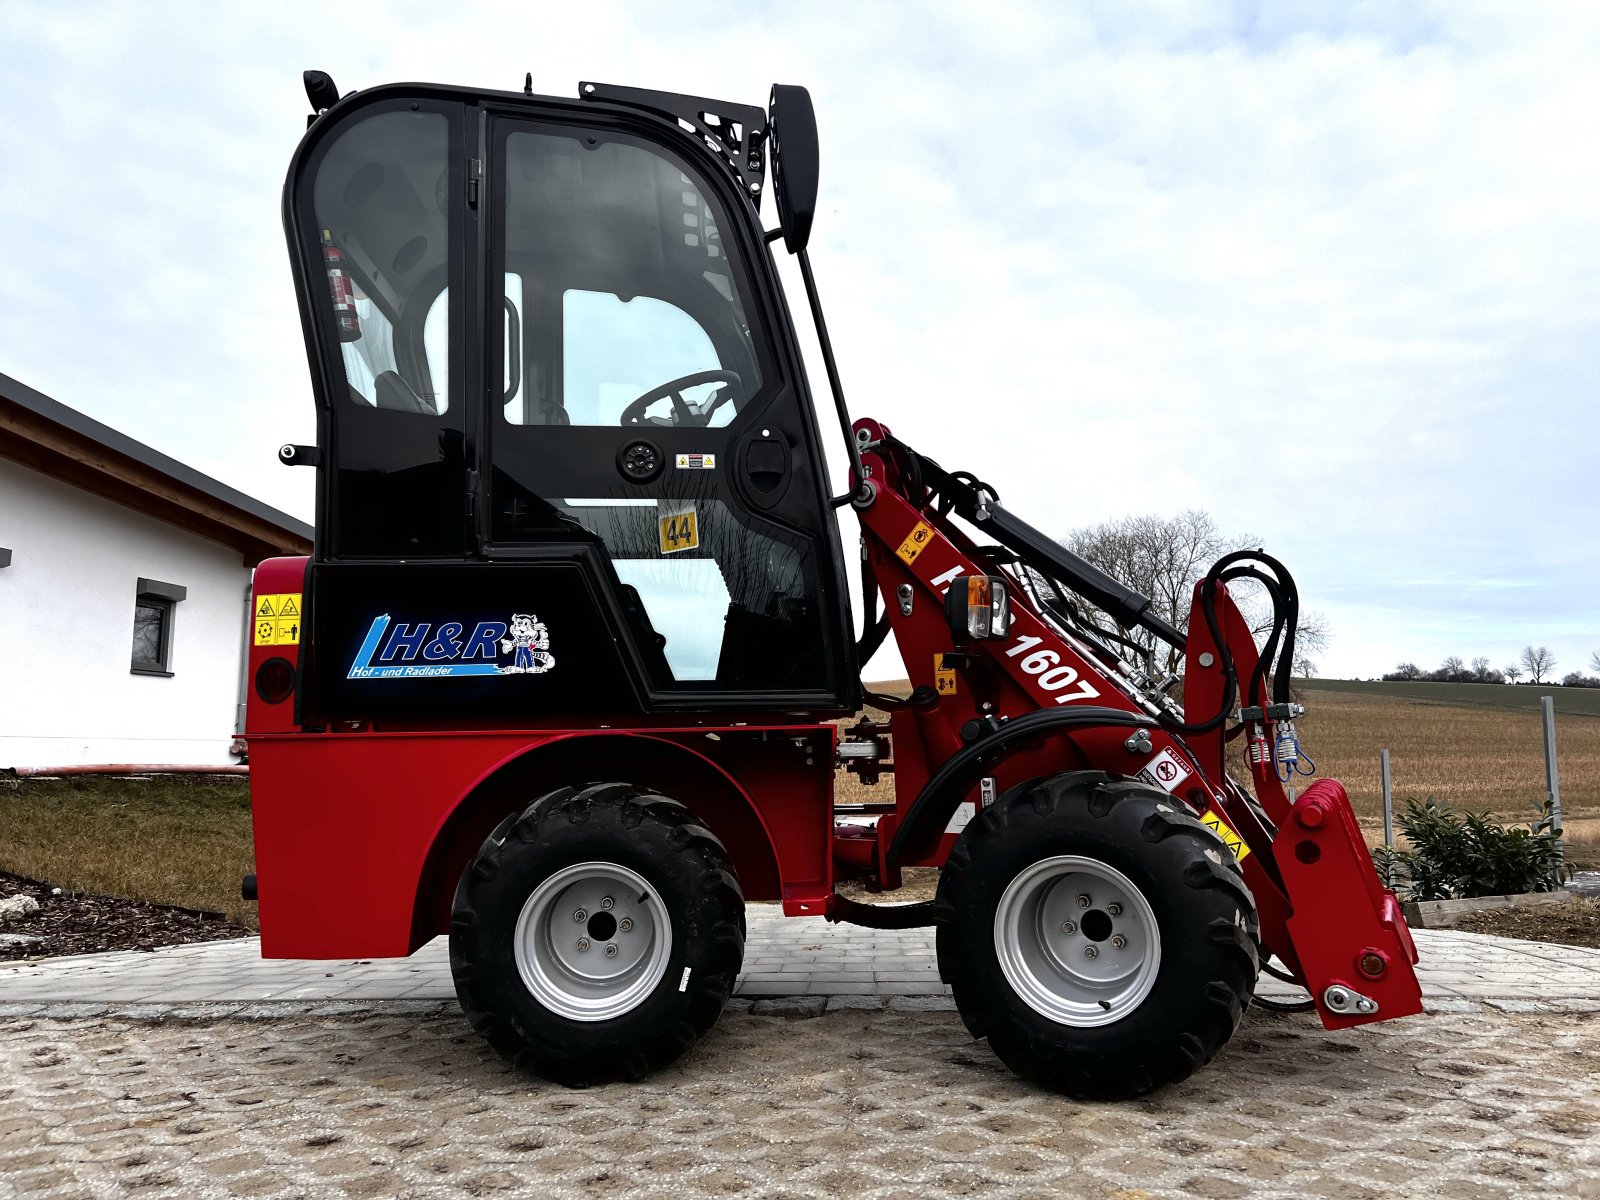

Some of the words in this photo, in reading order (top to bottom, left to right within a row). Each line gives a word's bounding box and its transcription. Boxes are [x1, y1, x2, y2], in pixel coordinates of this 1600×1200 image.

[667, 517, 692, 546] 44
[380, 622, 507, 661] H&R
[381, 667, 403, 676] und
[404, 667, 453, 676] Radlader
[1005, 634, 1101, 704] 1607
[1171, 753, 1191, 772] GEFAHR
